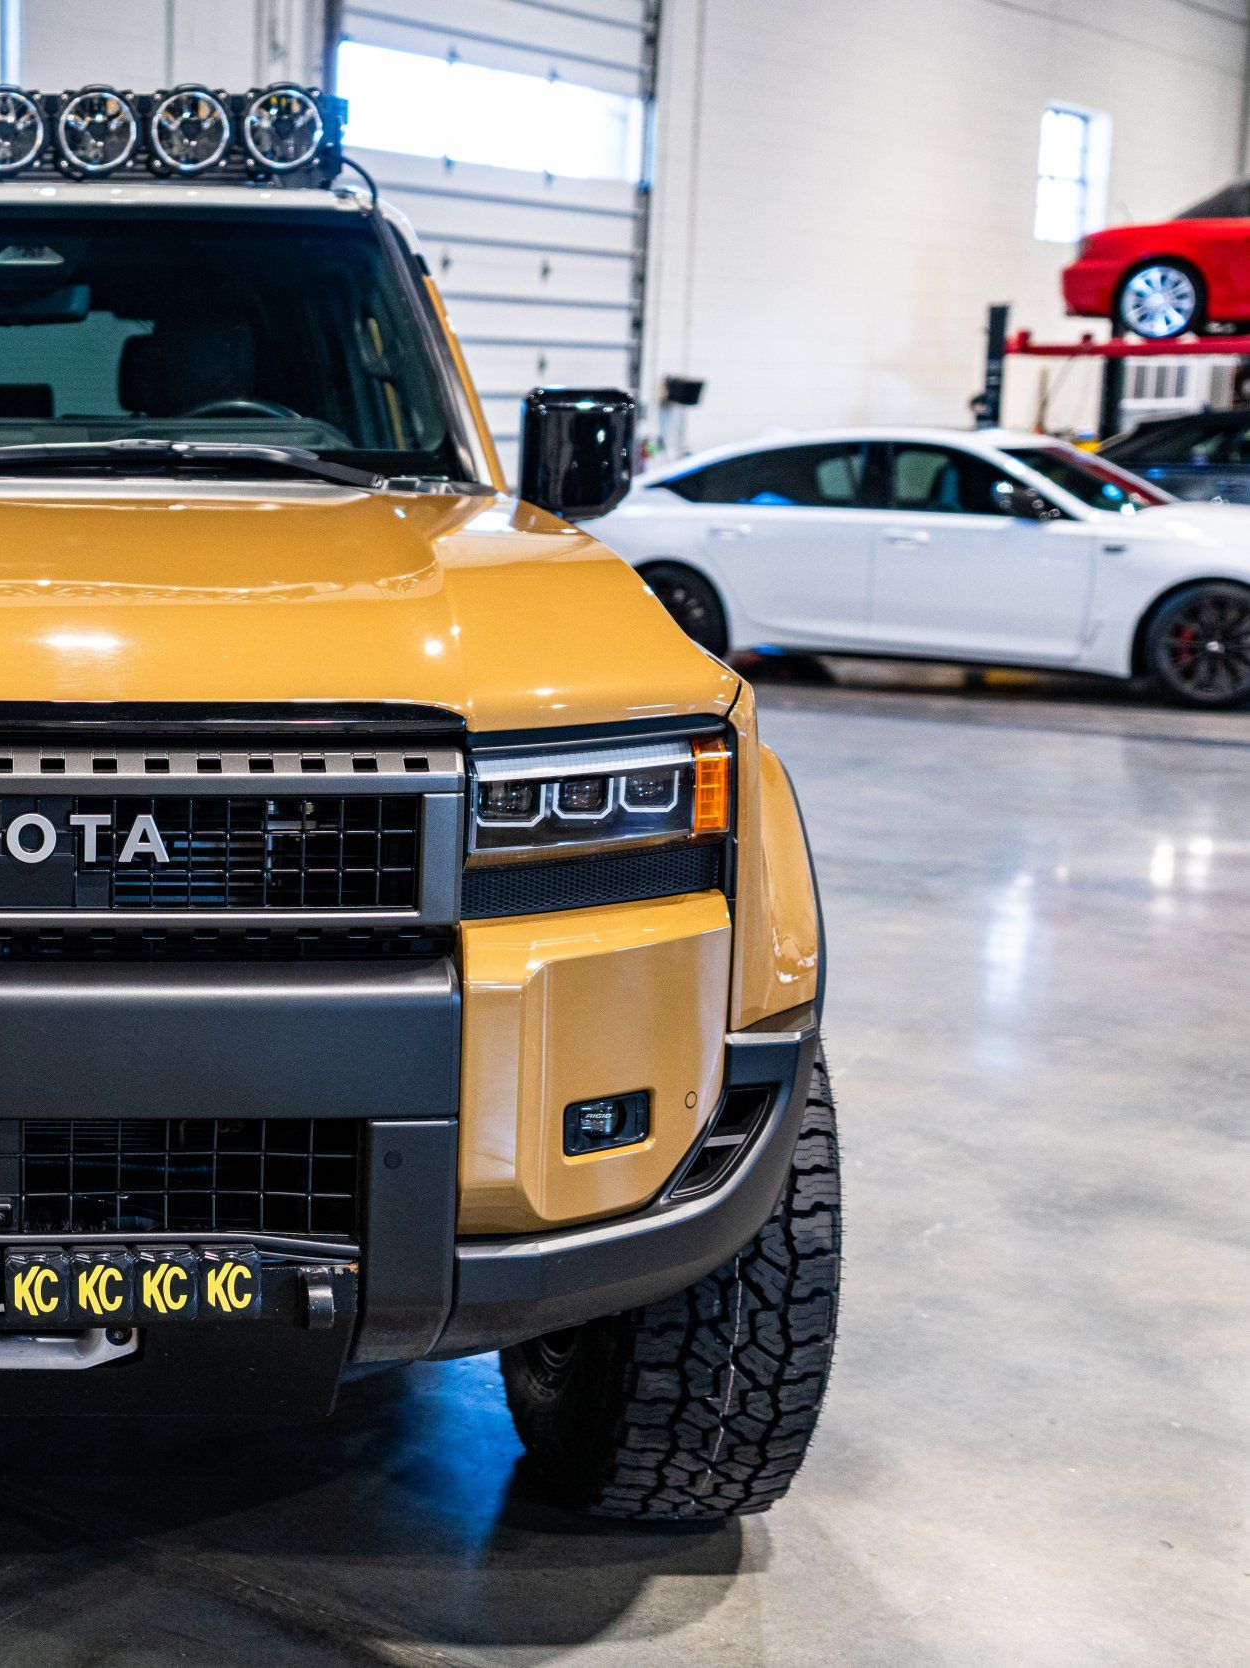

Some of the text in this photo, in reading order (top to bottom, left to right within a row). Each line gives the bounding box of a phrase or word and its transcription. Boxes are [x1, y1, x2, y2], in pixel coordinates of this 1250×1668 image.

[14, 1266, 58, 1316] KC
[79, 1265, 123, 1314] KC
[143, 1264, 186, 1313] KC
[208, 1262, 251, 1312] KC
